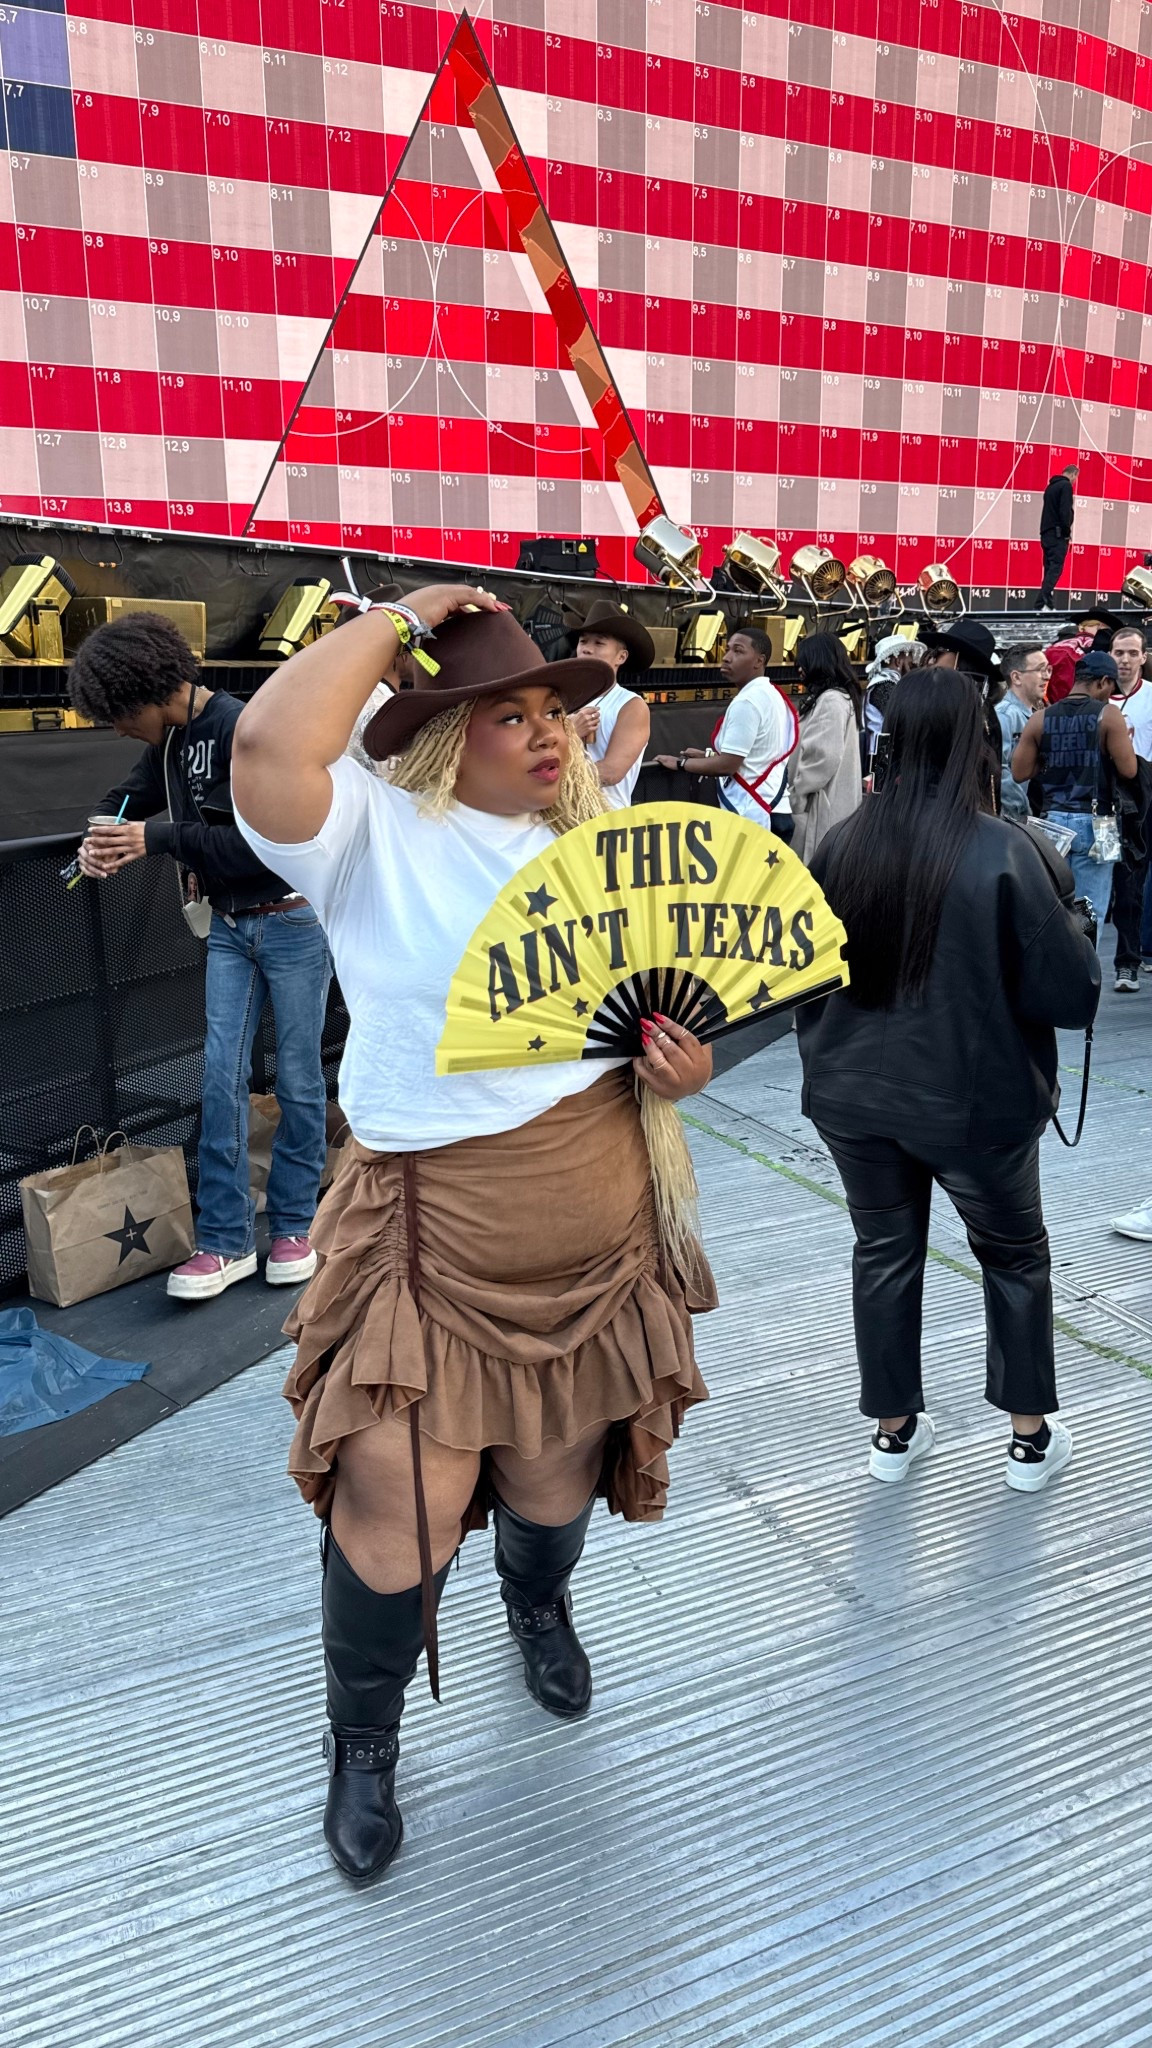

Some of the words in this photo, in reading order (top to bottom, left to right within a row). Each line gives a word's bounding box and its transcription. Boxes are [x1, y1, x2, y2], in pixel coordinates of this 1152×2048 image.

[0, 9, 17, 23] 6,7
[381, 4, 404, 17] 5,13
[696, 5, 709, 17] 4,5
[743, 15, 757, 27] 4,6
[67, 21, 87, 35] 6,8
[493, 25, 508, 37] 5,1
[789, 25, 802, 37] 4,7
[135, 32, 154, 46] 6,9
[547, 36, 561, 48] 5,2
[200, 42, 226, 57] 6,10
[598, 47, 612, 59] 5,3
[877, 45, 889, 56] 4,9
[263, 52, 286, 66] 6,11
[648, 57, 661, 68] 5,4
[324, 62, 347, 75] 6,12
[696, 67, 709, 78] 5,5
[959, 63, 975, 74] 4,11
[742, 76, 755, 88] 5,6
[999, 72, 1014, 82] 4,12
[5, 83, 24, 97] 7,7
[787, 85, 800, 97] 5,7
[74, 93, 93, 107] 7,8
[141, 103, 159, 117] 7,9
[547, 100, 561, 112] 6,2
[874, 103, 887, 114] 5,9
[205, 112, 230, 127] 7,10
[598, 110, 612, 121] 6,3
[268, 121, 289, 135] 7,11
[647, 119, 660, 131] 6,4
[957, 119, 971, 129] 5,11
[328, 130, 351, 142] 7,12
[431, 127, 445, 138] 4,1
[694, 128, 708, 139] 6,5
[741, 136, 754, 147] 6,6
[1034, 134, 1049, 145] 5,13
[11, 156, 30, 170] 8,7
[548, 162, 562, 175] 7,2
[79, 165, 98, 179] 8,8
[598, 172, 612, 183] 7,3
[913, 167, 929, 178] 6,10
[145, 173, 164, 186] 8,9
[209, 181, 234, 195] 8,10
[647, 180, 660, 191] 7,4
[270, 188, 293, 202] 8,11
[433, 188, 447, 199] 5,1
[694, 188, 707, 198] 7,5
[1030, 188, 1046, 198] 6,13
[740, 195, 753, 206] 7,6
[785, 202, 797, 213] 7,7
[911, 223, 927, 233] 7,10
[17, 228, 36, 241] 9,7
[599, 233, 612, 244] 8,3
[85, 235, 104, 248] 9,8
[382, 240, 397, 251] 6,5
[647, 240, 660, 250] 8,4
[1027, 241, 1042, 251] 7,13
[150, 242, 169, 255] 9,9
[434, 247, 448, 258] 6,1
[693, 247, 706, 257] 8,5
[213, 249, 238, 262] 9,10
[274, 255, 297, 267] 9,11
[485, 253, 499, 264] 6,2
[739, 253, 752, 264] 8,6
[783, 259, 795, 269] 8,7
[908, 278, 924, 288] 8,10
[599, 292, 613, 302] 9,3
[1024, 292, 1039, 303] 8,13
[25, 298, 49, 311] 10,7
[385, 300, 399, 310] 7,5
[646, 298, 659, 308] 9,4
[91, 304, 116, 316] 10,8
[693, 304, 706, 315] 9,5
[738, 309, 751, 320] 9,6
[156, 310, 180, 322] 10,9
[219, 315, 249, 328] 10,10
[486, 311, 499, 321] 7,2
[781, 315, 794, 325] 9,7
[865, 326, 877, 335] 9,9
[945, 335, 960, 345] 9,11
[1021, 344, 1036, 354] 9,13
[334, 353, 349, 364] 8,4
[387, 358, 402, 369] 8,5
[648, 357, 665, 367] 10,4
[437, 363, 451, 373] 8,1
[486, 367, 500, 377] 8,2
[693, 362, 710, 372] 10,5
[738, 366, 754, 377] 10,6
[31, 367, 55, 379] 11,7
[97, 372, 121, 384] 11,8
[535, 370, 548, 381] 8,3
[161, 376, 184, 388] 11,9
[823, 375, 839, 385] 10,8
[223, 380, 252, 392] 11,10
[904, 383, 924, 394] 10,10
[1018, 395, 1037, 404] 10,13
[337, 412, 352, 422] 9,4
[389, 415, 403, 426] 9,5
[647, 414, 664, 424] 11,4
[439, 419, 453, 429] 9,1
[488, 423, 502, 433] 9,2
[693, 418, 709, 428] 11,5
[737, 422, 753, 432] 11,6
[536, 427, 549, 436] 9,3
[822, 429, 837, 438] 11,8
[37, 434, 61, 446] 12,7
[102, 437, 127, 450] 12,8
[902, 435, 921, 445] 11,10
[165, 440, 189, 452] 12,9
[286, 467, 307, 477] 10,3
[340, 470, 360, 480] 10,4
[391, 473, 411, 483] 10,5
[441, 476, 459, 486] 10,1
[692, 473, 709, 483] 12,5
[736, 476, 752, 486] 12,6
[778, 479, 795, 488] 12,7
[489, 479, 508, 489] 10,2
[537, 482, 555, 491] 10,3
[583, 484, 600, 494] 10,4
[900, 487, 919, 496] 12,10
[1013, 494, 1031, 502] 12,13
[43, 500, 67, 512] 13,7
[108, 502, 132, 514] 13,8
[170, 504, 194, 516] 13,9
[291, 524, 310, 535] 11,3
[343, 526, 362, 537] 11,4
[394, 529, 413, 539] 11,5
[444, 532, 461, 541] 11,1
[491, 533, 509, 543] 11,2
[777, 532, 793, 542] 13,7
[859, 535, 875, 544] 13,9
[936, 538, 955, 548] 13,11
[1010, 542, 1028, 550] 13,13
[1051, 733, 1087, 751] BEEN
[1047, 750, 1099, 767] OUNTRY
[596, 820, 717, 893] THIS
[488, 908, 629, 1022] AIN'T
[668, 903, 814, 971] TEXAS
